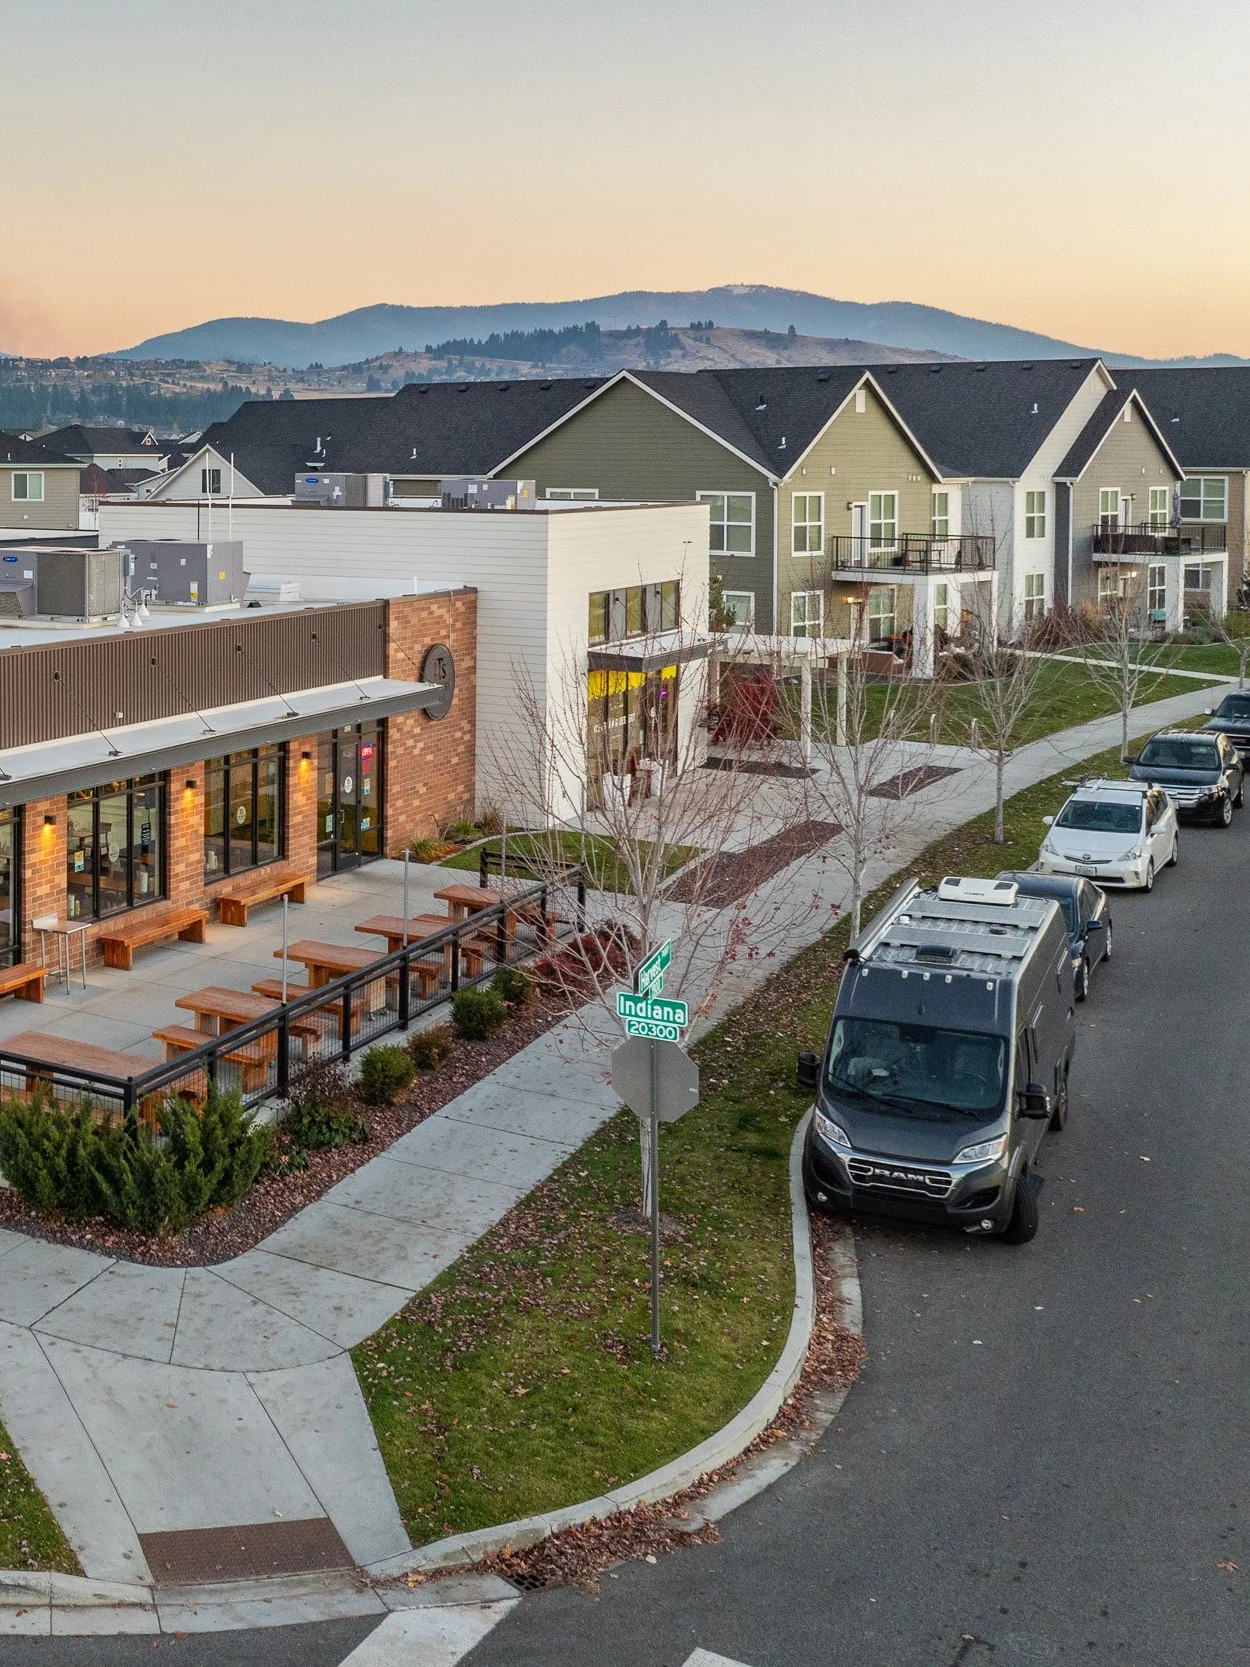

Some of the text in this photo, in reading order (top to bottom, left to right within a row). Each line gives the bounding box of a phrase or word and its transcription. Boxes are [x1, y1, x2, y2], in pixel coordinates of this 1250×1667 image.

[620, 995, 685, 1024] Indiana
[630, 1021, 676, 1040] 20300
[874, 1168, 925, 1182] RAM
